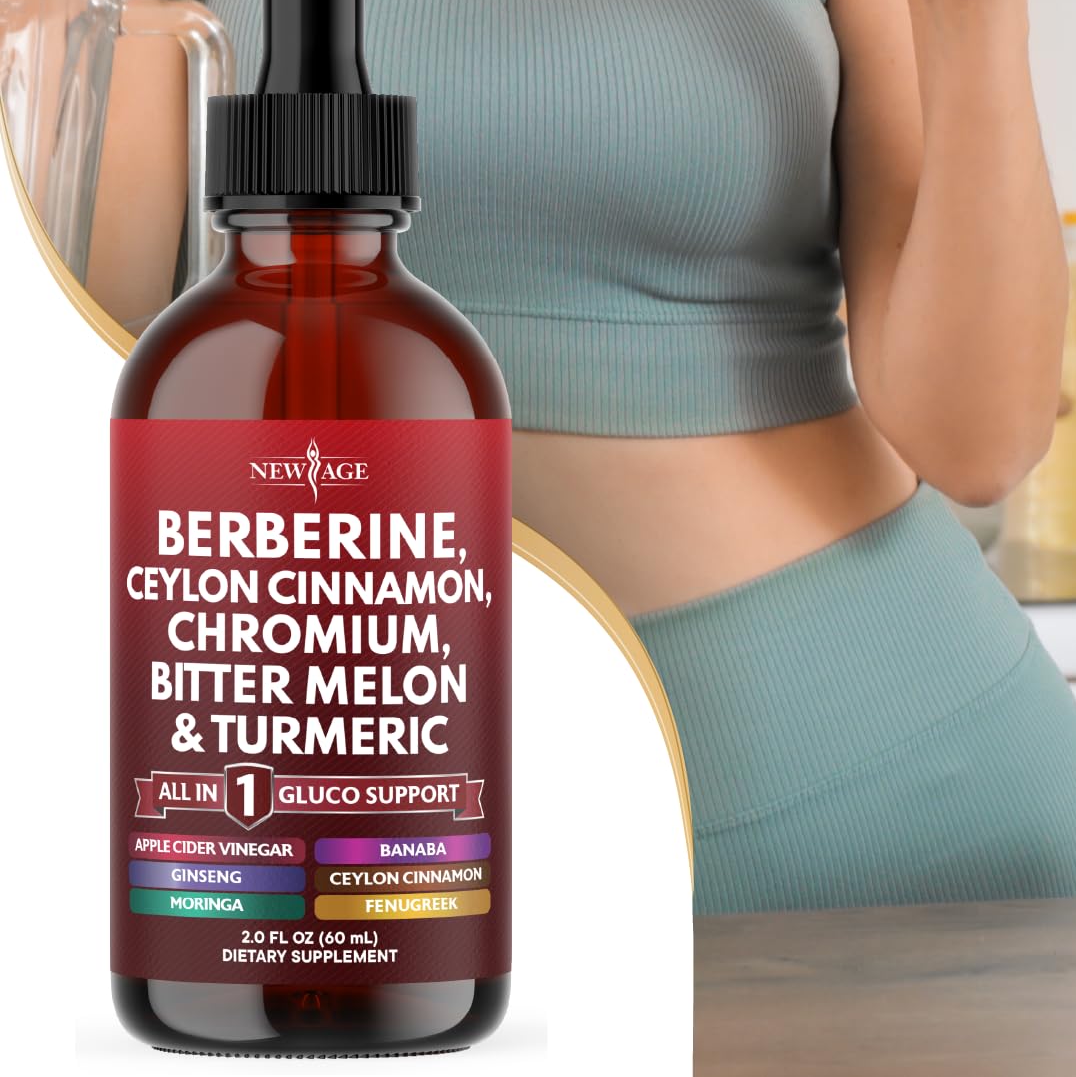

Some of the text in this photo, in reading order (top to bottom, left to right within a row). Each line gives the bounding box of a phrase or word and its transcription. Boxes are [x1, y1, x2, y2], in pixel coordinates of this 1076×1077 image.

[249, 462, 369, 480] NEW AGE
[158, 510, 467, 564] BERBERINE,
[126, 566, 493, 608] CEYLON CINNAMON,
[167, 611, 451, 660] CHROMIUM,
[151, 661, 467, 706] BITTER MELON
[171, 713, 449, 755] & TURMERIC
[158, 773, 460, 817] ALL IN 1 GLUCO SUPPORT
[134, 838, 294, 858] APPLE CIDER VINEGAR
[379, 842, 447, 858] BANABA
[171, 869, 242, 884] GINSENG
[329, 867, 483, 886] CEYLON CINNAMON
[170, 896, 244, 913] MORINGA
[365, 897, 458, 913] FENUGREEK
[241, 930, 378, 946] 2.0 FL OZ (60 mL)
[222, 949, 398, 964] DIETARY SUPPLEMENT
